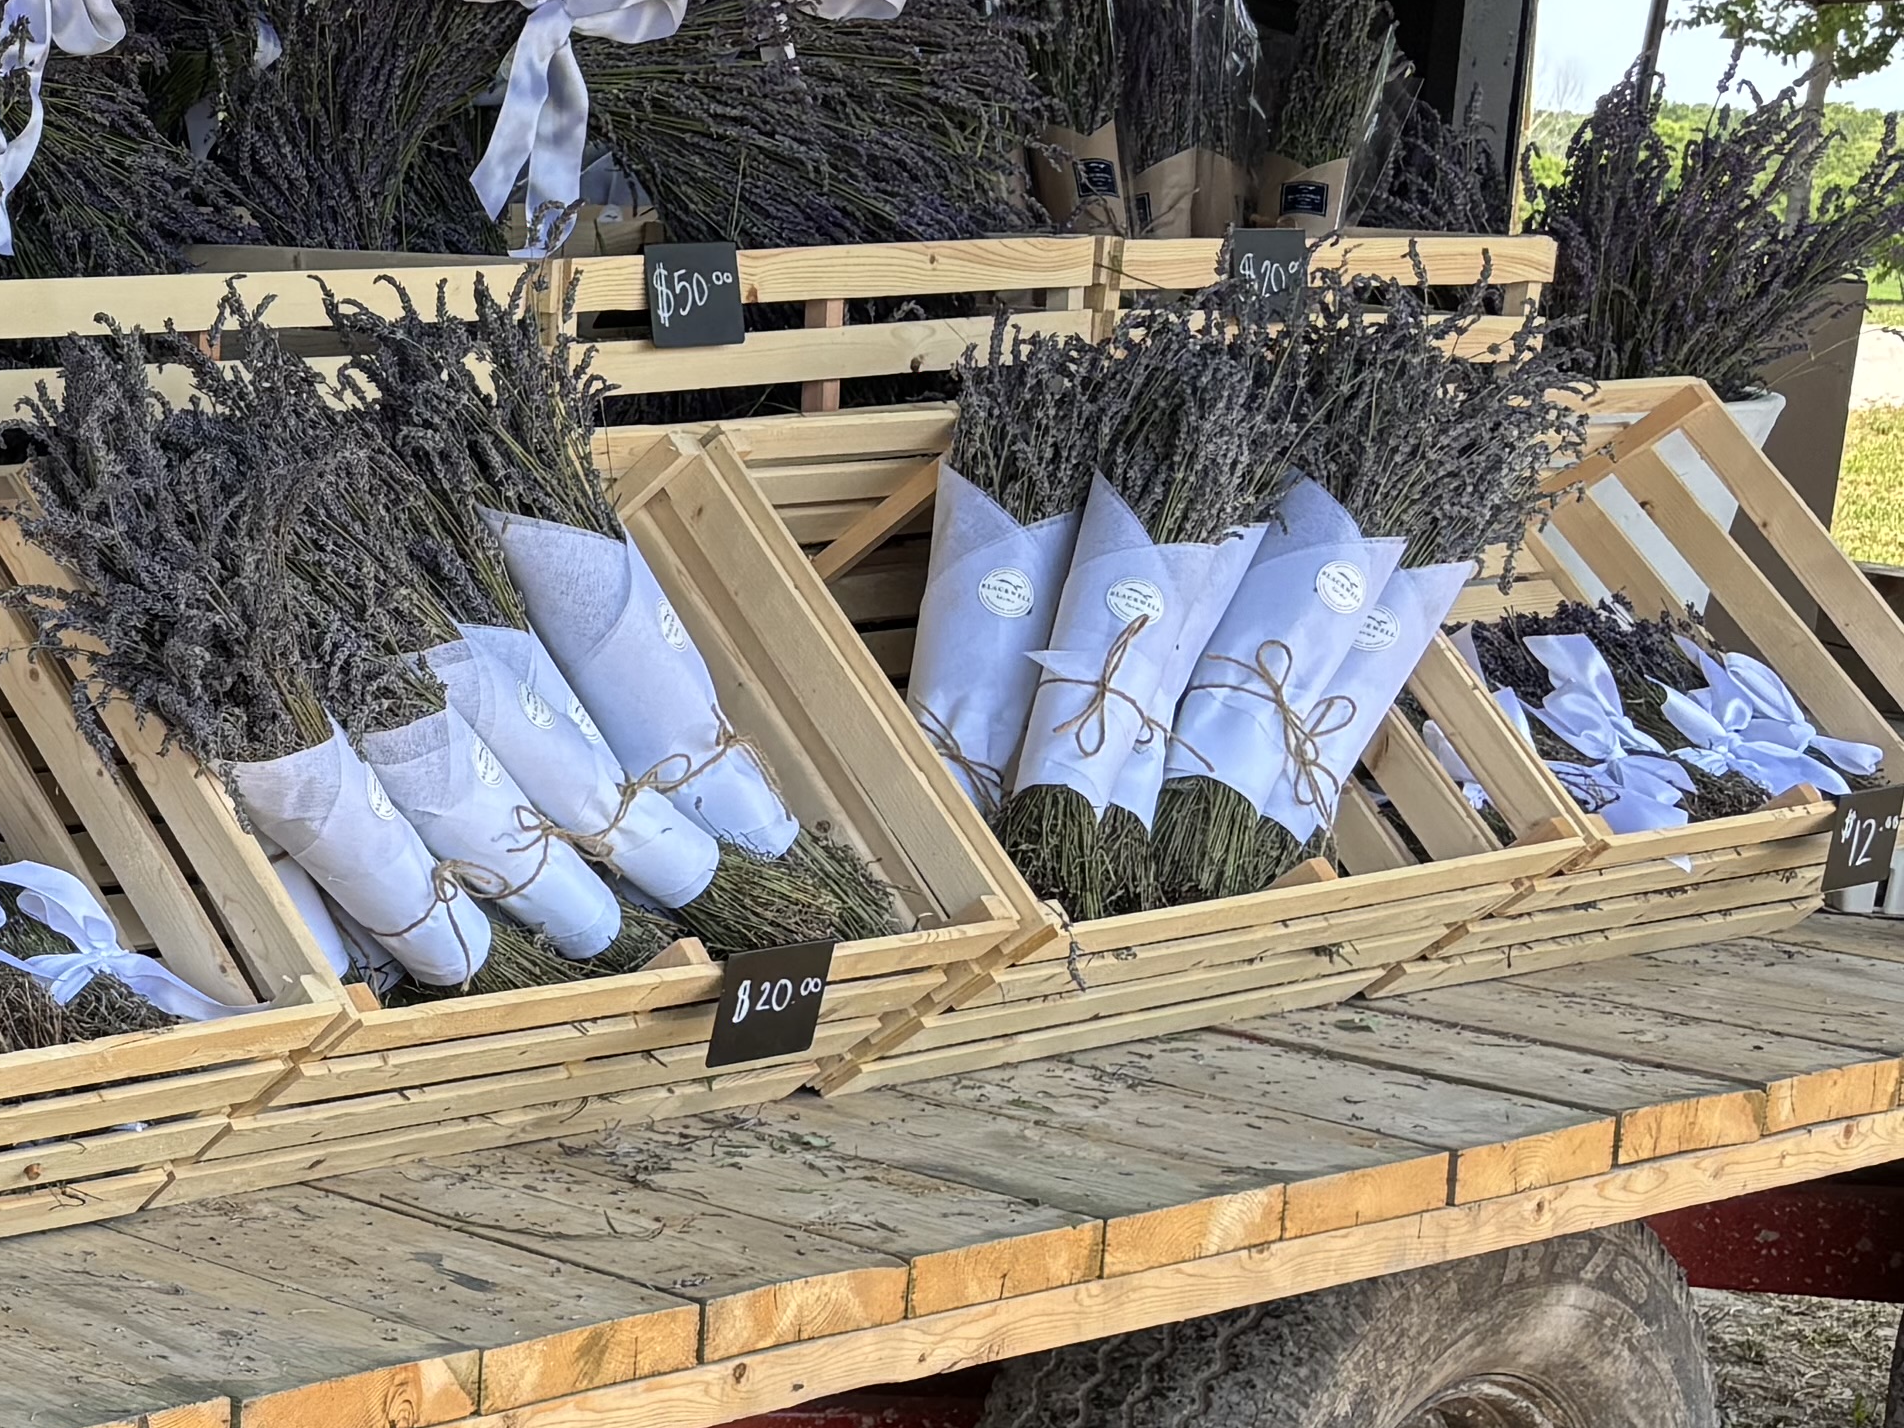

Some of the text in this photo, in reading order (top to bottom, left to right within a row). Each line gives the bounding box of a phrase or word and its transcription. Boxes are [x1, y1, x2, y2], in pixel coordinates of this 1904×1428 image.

[653, 262, 733, 327] $50.00
[1841, 808, 1899, 867] $12.00
[732, 976, 822, 1024] $20.00
